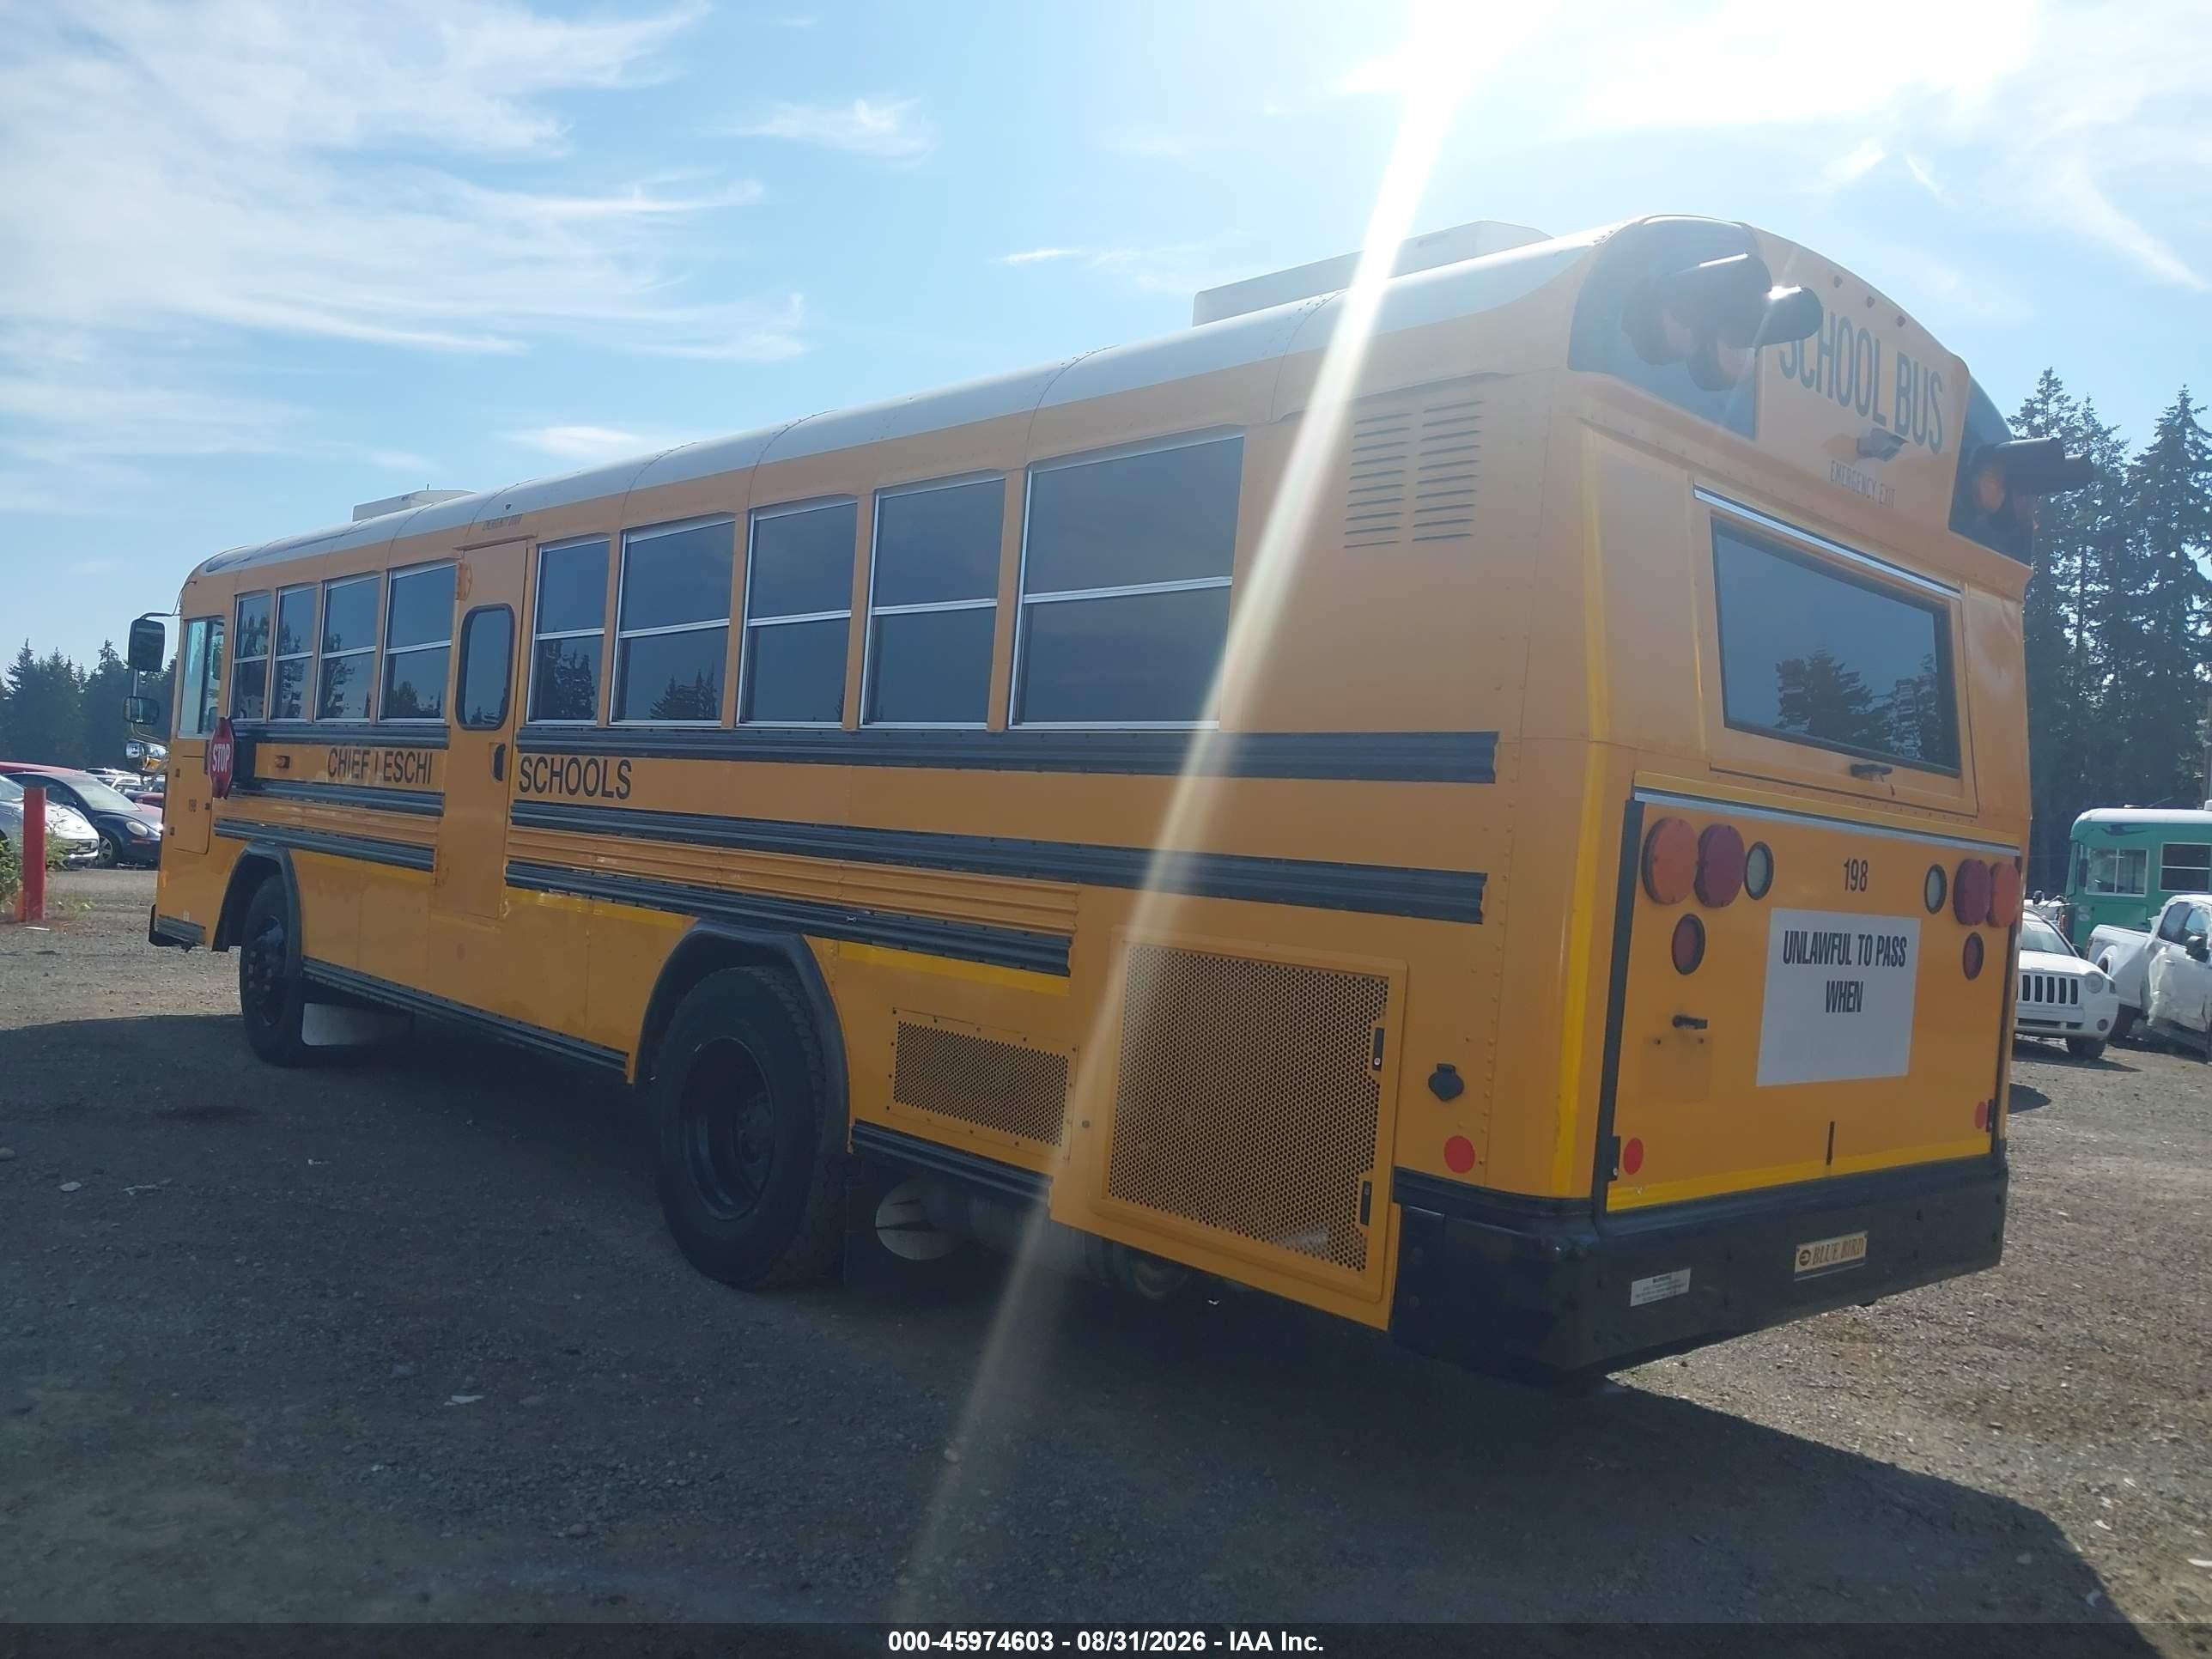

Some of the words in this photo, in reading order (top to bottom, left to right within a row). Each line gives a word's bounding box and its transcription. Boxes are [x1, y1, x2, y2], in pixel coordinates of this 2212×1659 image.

[1894, 350, 1943, 455] BUS
[212, 743, 231, 773] STOP
[327, 747, 372, 780] CHIEF
[519, 756, 632, 800] SCHOOLS
[1844, 858, 1869, 892] 198
[1783, 930, 1852, 966] UNLAWFUL
[1857, 933, 1874, 967] TO
[1875, 935, 1907, 968] PASS
[1826, 980, 1864, 1013] WHEN
